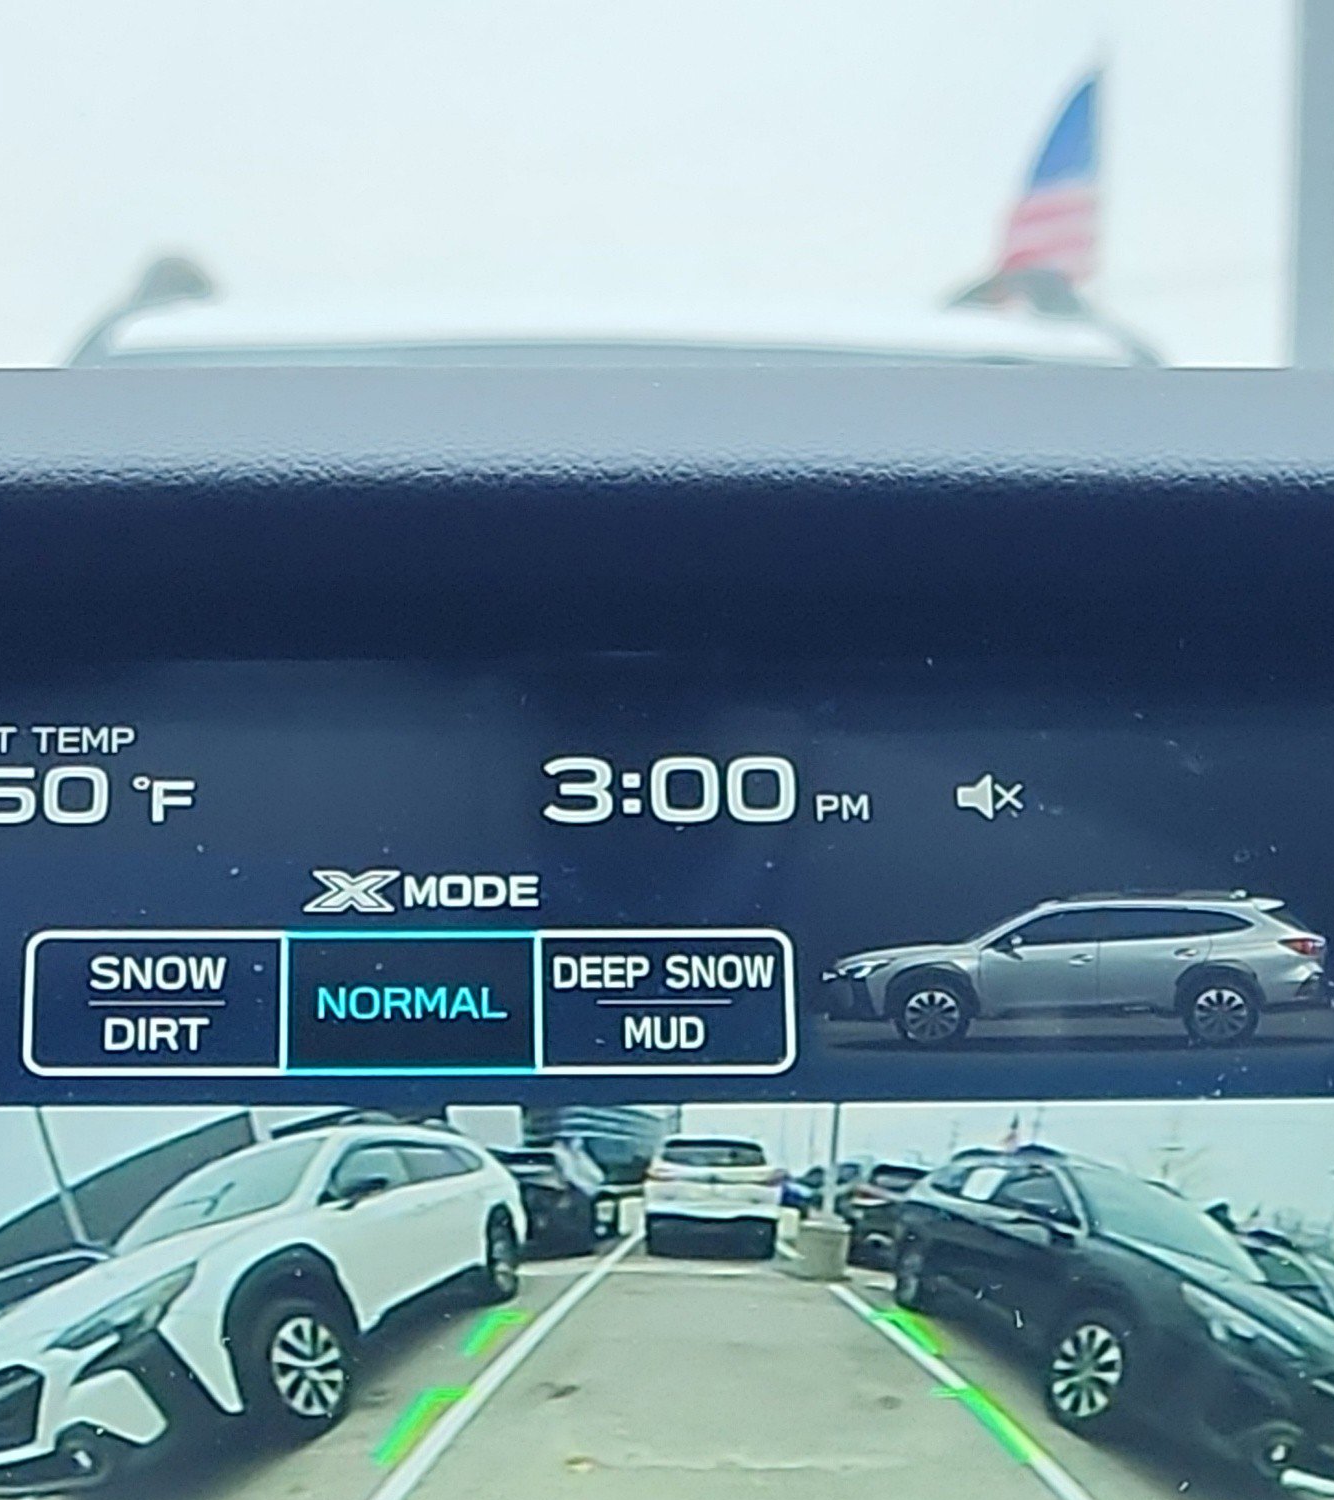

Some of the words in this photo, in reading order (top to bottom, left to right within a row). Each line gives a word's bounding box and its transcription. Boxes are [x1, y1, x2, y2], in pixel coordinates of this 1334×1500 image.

[32, 726, 135, 754] TEMP
[542, 757, 796, 823] 3:00
[815, 794, 870, 822] PM
[89, 955, 226, 990] SNOW
[553, 955, 650, 989] DEEP
[665, 955, 774, 989] SNOW
[317, 986, 507, 1020] NORMAL
[103, 1017, 209, 1052] DIRT
[624, 1016, 705, 1050] MUD
